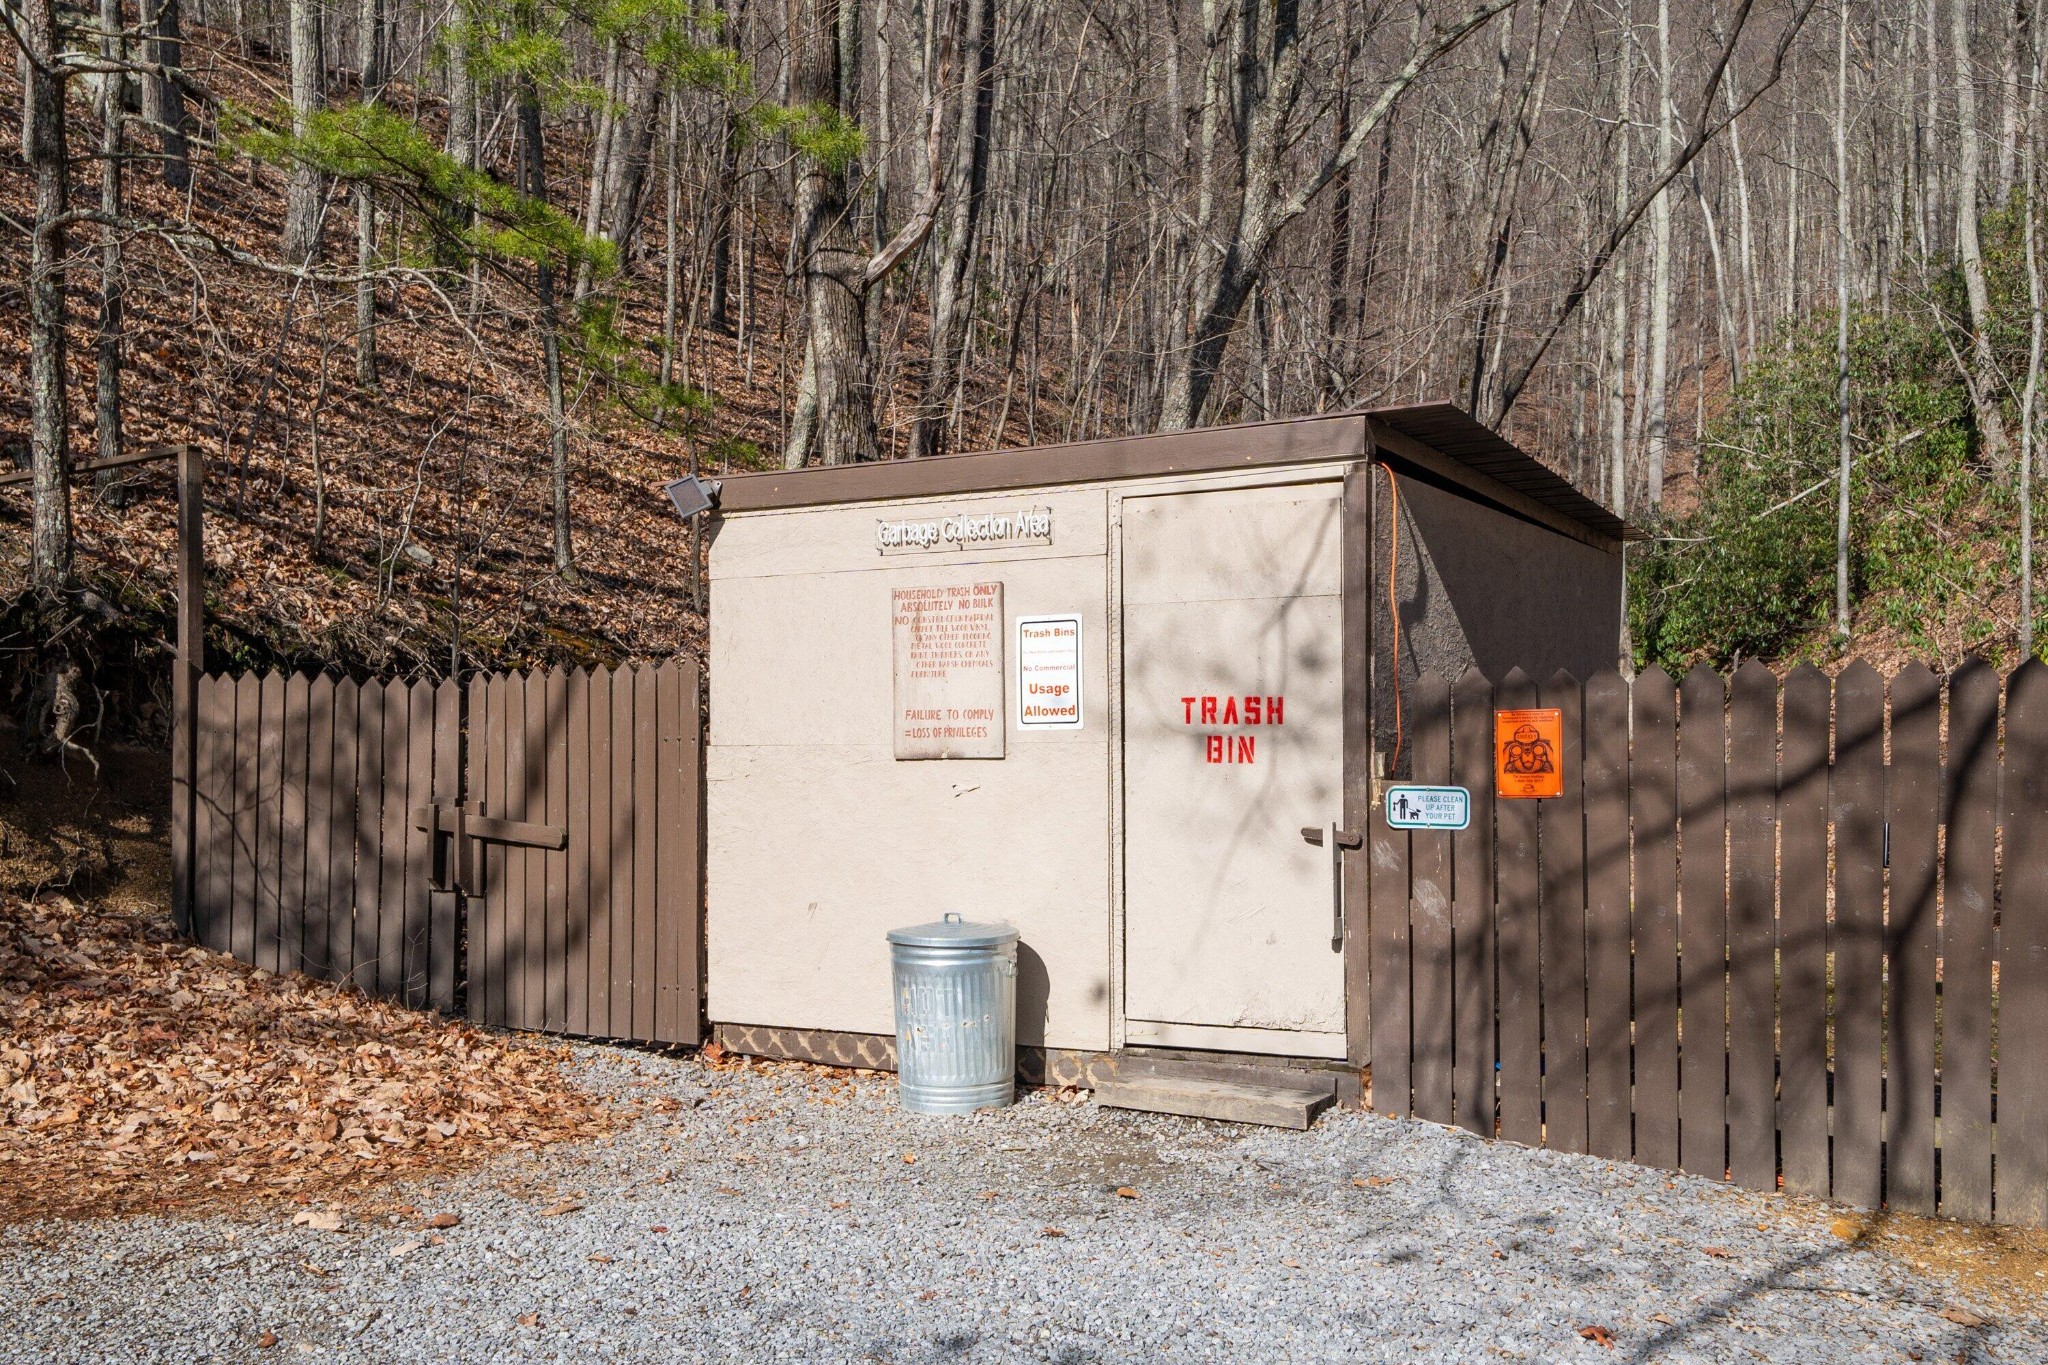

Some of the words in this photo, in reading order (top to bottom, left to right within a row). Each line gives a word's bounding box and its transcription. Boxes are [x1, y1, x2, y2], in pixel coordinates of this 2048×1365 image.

[877, 520, 937, 545] Garbage
[941, 513, 1011, 541] Collection
[1014, 510, 1050, 536] Area
[893, 588, 943, 600] HOUSEHOLD
[947, 586, 971, 597] TRASH
[973, 585, 997, 596] ONLY
[900, 600, 953, 612] ABSOLUTELY
[958, 599, 970, 609] NO
[973, 598, 993, 608] BULK
[894, 615, 909, 625] NO
[1023, 629, 1051, 638] Trash
[1054, 628, 1075, 637] Bins
[1029, 683, 1070, 696] Usage
[905, 709, 942, 720] FAILURE
[947, 709, 959, 720] TO
[963, 708, 994, 721] COMPLY
[1024, 705, 1076, 716] Allowed
[1180, 696, 1284, 725] TRASH
[933, 727, 942, 737] OF
[944, 727, 988, 738] PRIVILEGES
[1206, 735, 1255, 764] BIN
[1425, 812, 1442, 820] YOUR
